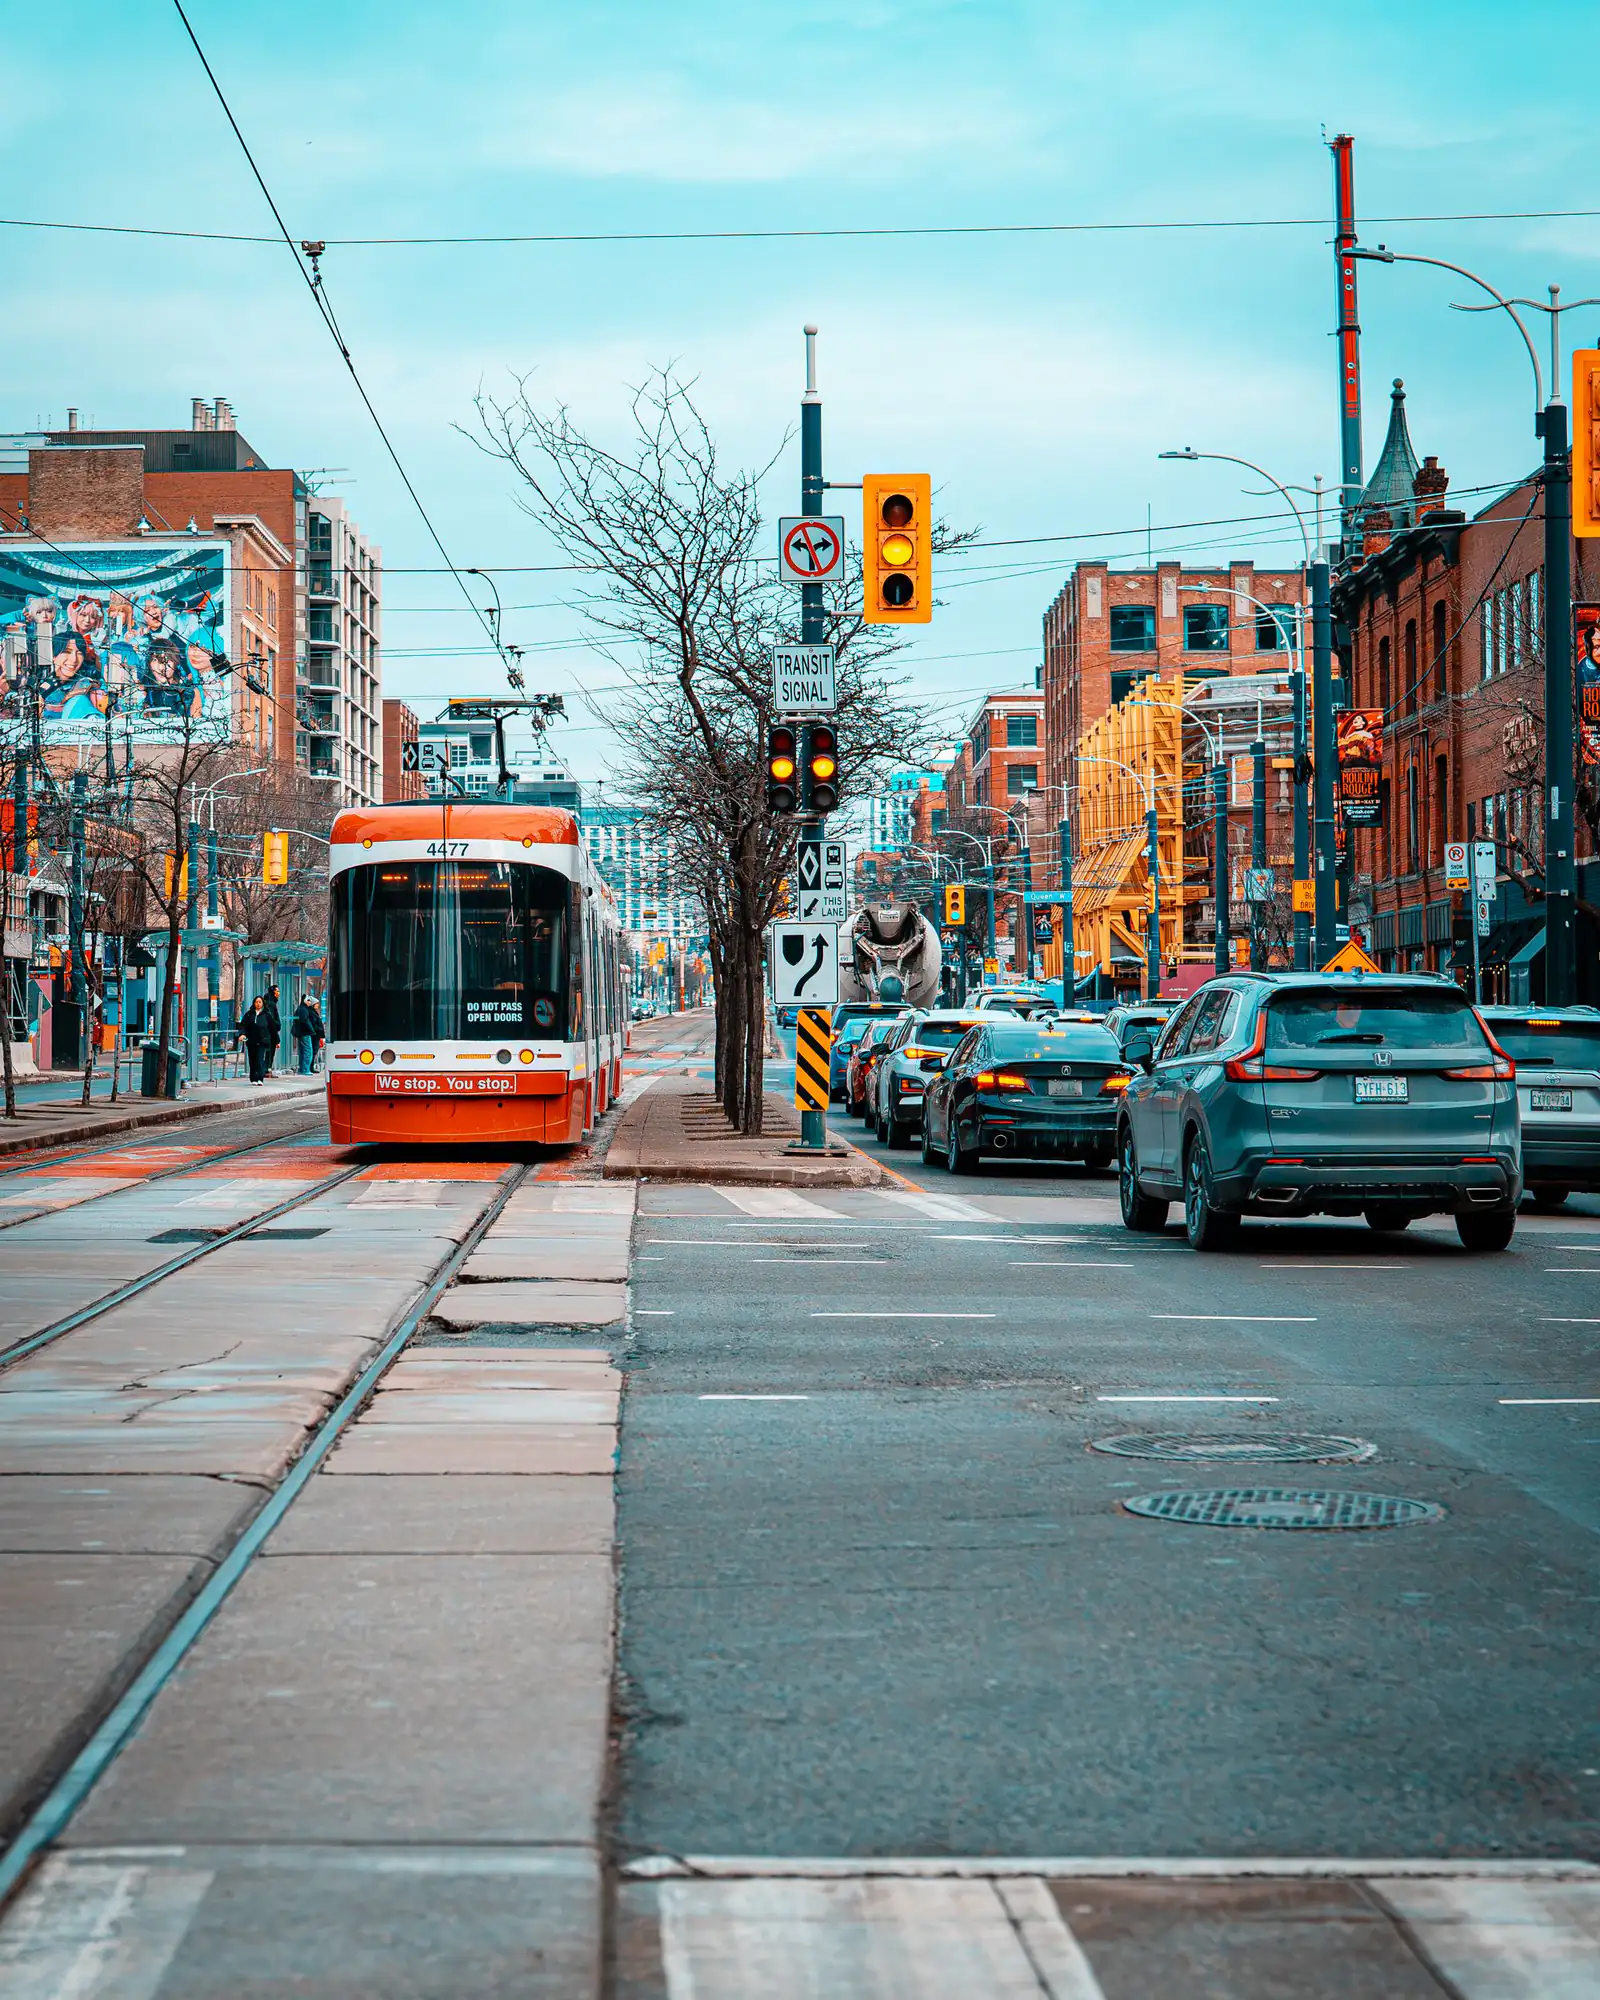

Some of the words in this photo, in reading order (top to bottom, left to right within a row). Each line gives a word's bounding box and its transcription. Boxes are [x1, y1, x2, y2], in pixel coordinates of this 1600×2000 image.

[777, 654, 830, 675] TRANSIT
[782, 681, 828, 702] SIGNAL
[1342, 772, 1374, 784] MOULIN
[426, 842, 469, 857] 4477
[1302, 882, 1312, 890] DO
[823, 896, 842, 906] THIS
[1030, 893, 1053, 901] Queen
[821, 907, 844, 917] LANE
[467, 1002, 479, 1011] DO
[481, 1002, 499, 1011] NOT
[501, 1002, 523, 1011] PASS
[467, 1013, 492, 1023] OPEN
[493, 1013, 523, 1023] DOORS
[378, 1075, 400, 1089] We
[404, 1077, 441, 1092] stop.
[446, 1077, 474, 1090] You
[477, 1077, 513, 1092] stop.
